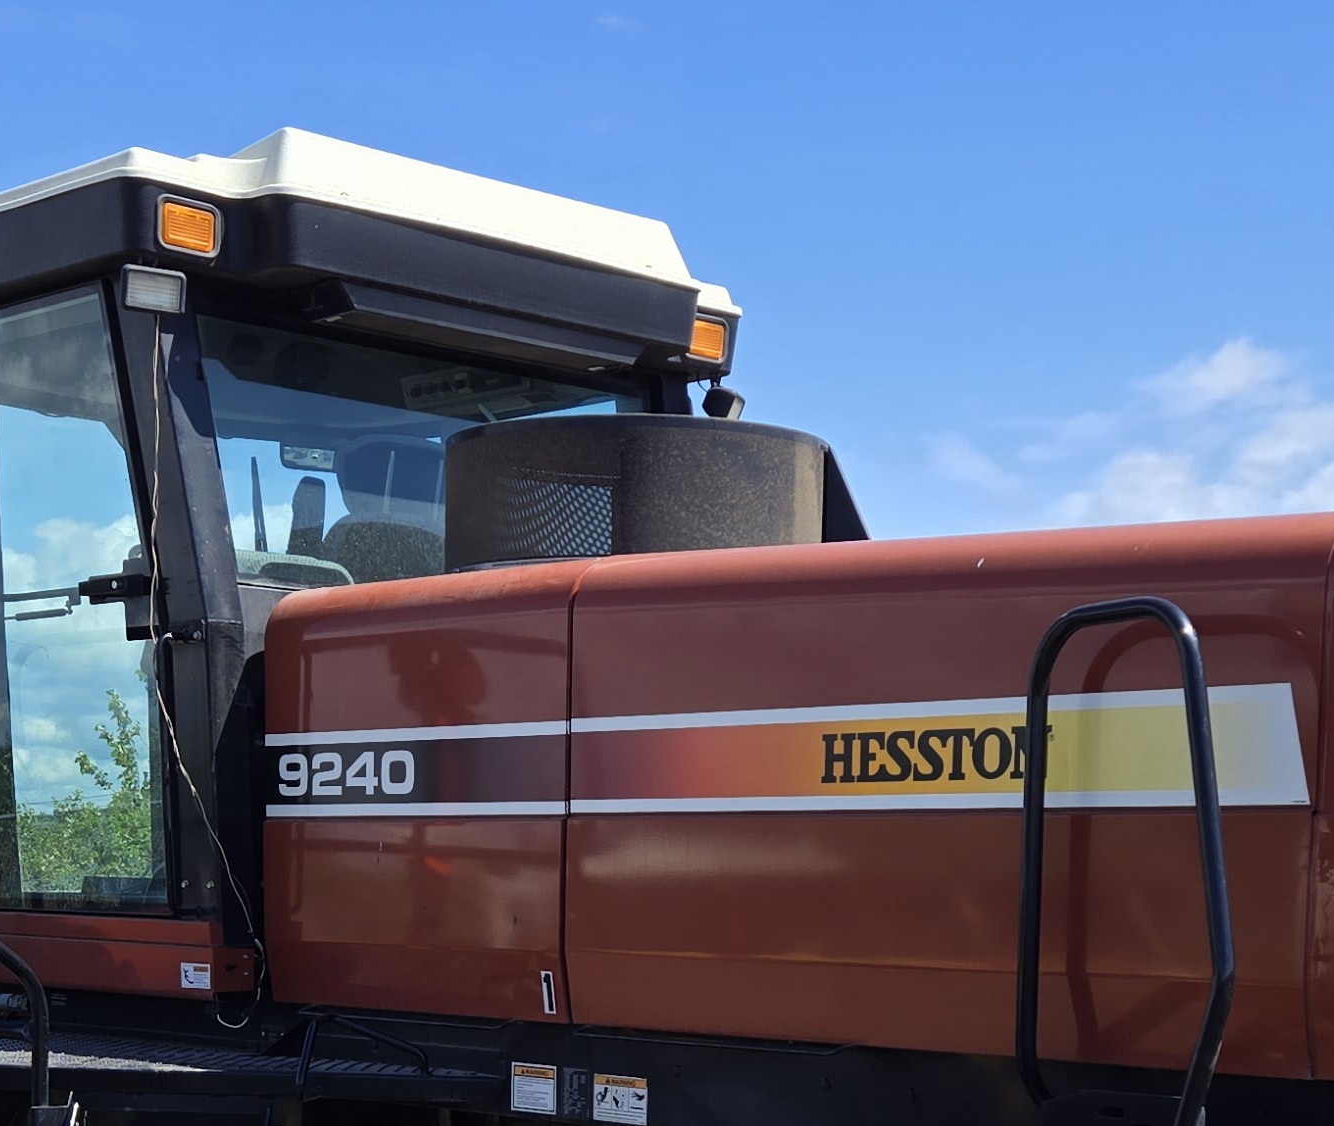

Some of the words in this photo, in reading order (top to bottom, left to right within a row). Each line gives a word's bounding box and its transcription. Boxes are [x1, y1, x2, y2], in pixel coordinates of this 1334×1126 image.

[278, 750, 415, 797] 9240
[525, 1068, 549, 1077] WARNING
[611, 1077, 637, 1087] WARNING
